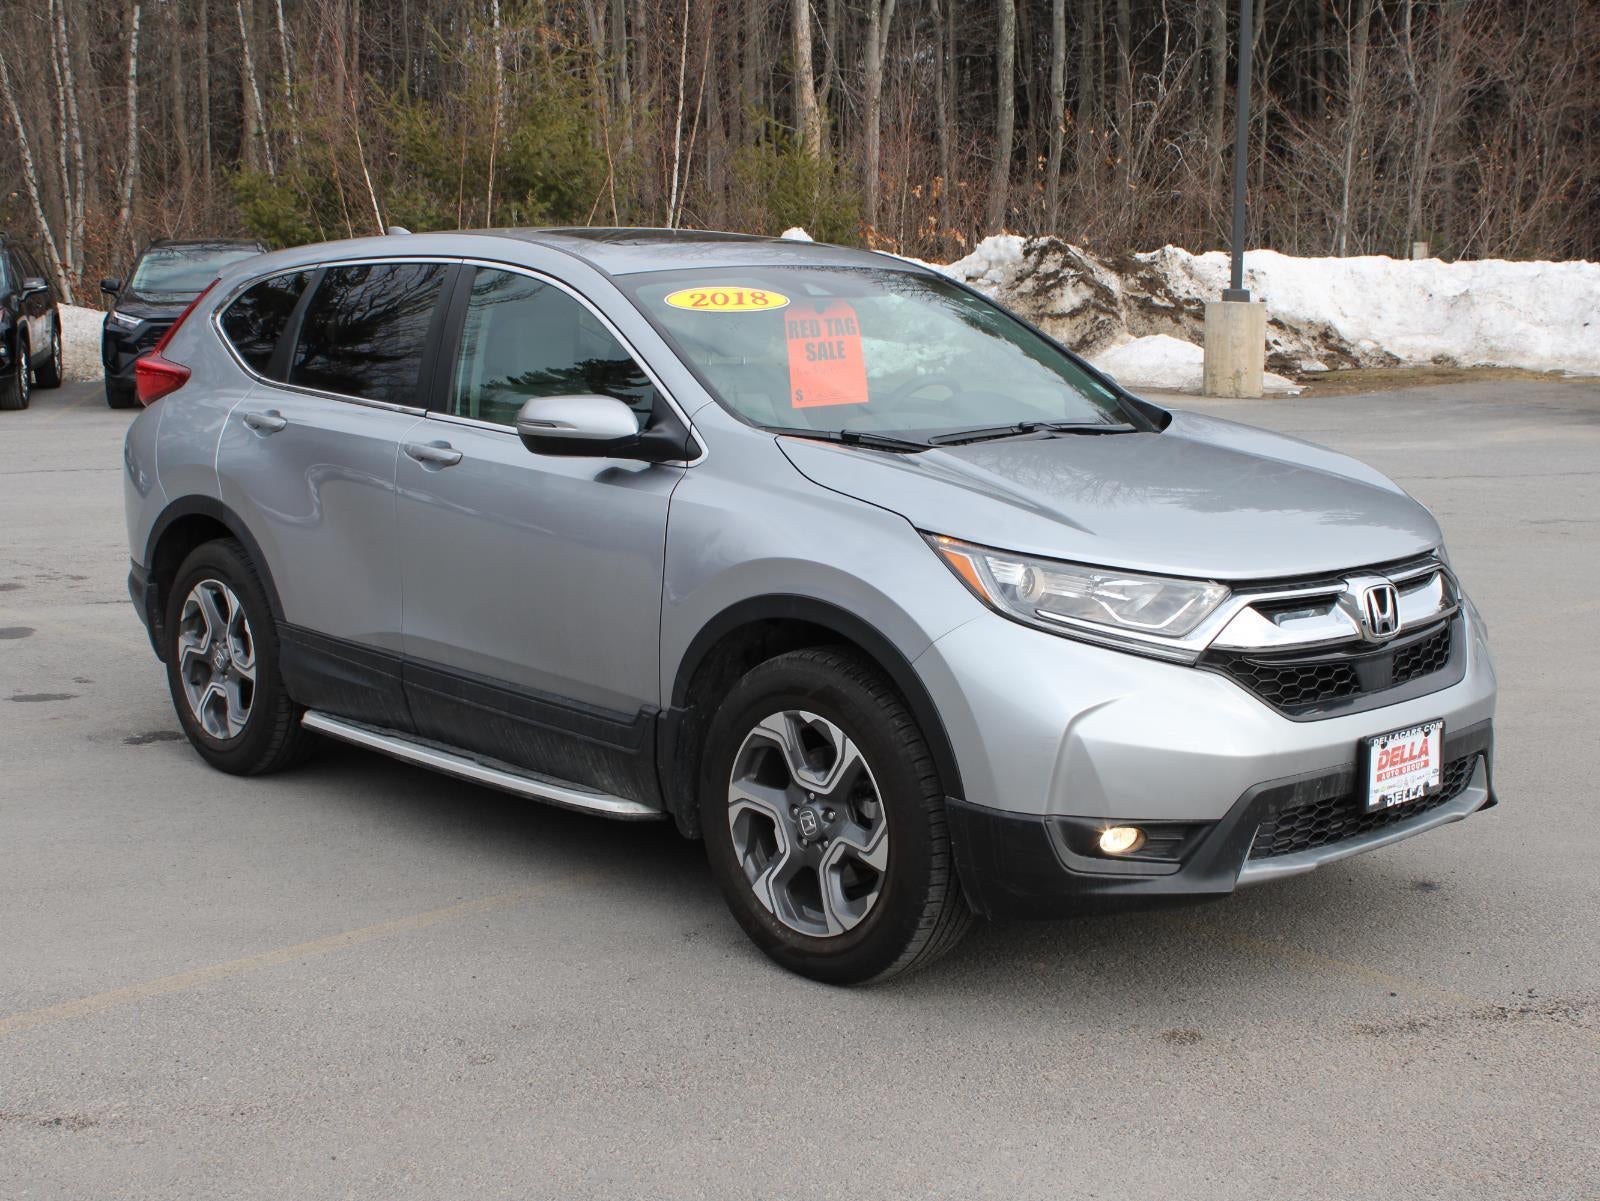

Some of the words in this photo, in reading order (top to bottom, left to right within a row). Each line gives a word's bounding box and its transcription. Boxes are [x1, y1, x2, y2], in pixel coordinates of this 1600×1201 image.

[689, 291, 769, 307] 2018
[788, 318, 821, 340] RED
[823, 317, 857, 337] TAG
[805, 340, 847, 362] SALE
[795, 388, 804, 402] $
[1377, 738, 1429, 771] DELLA
[1381, 768, 1400, 781] AUTO
[1402, 761, 1425, 773] GROUP
[1386, 784, 1425, 807] DELLA
